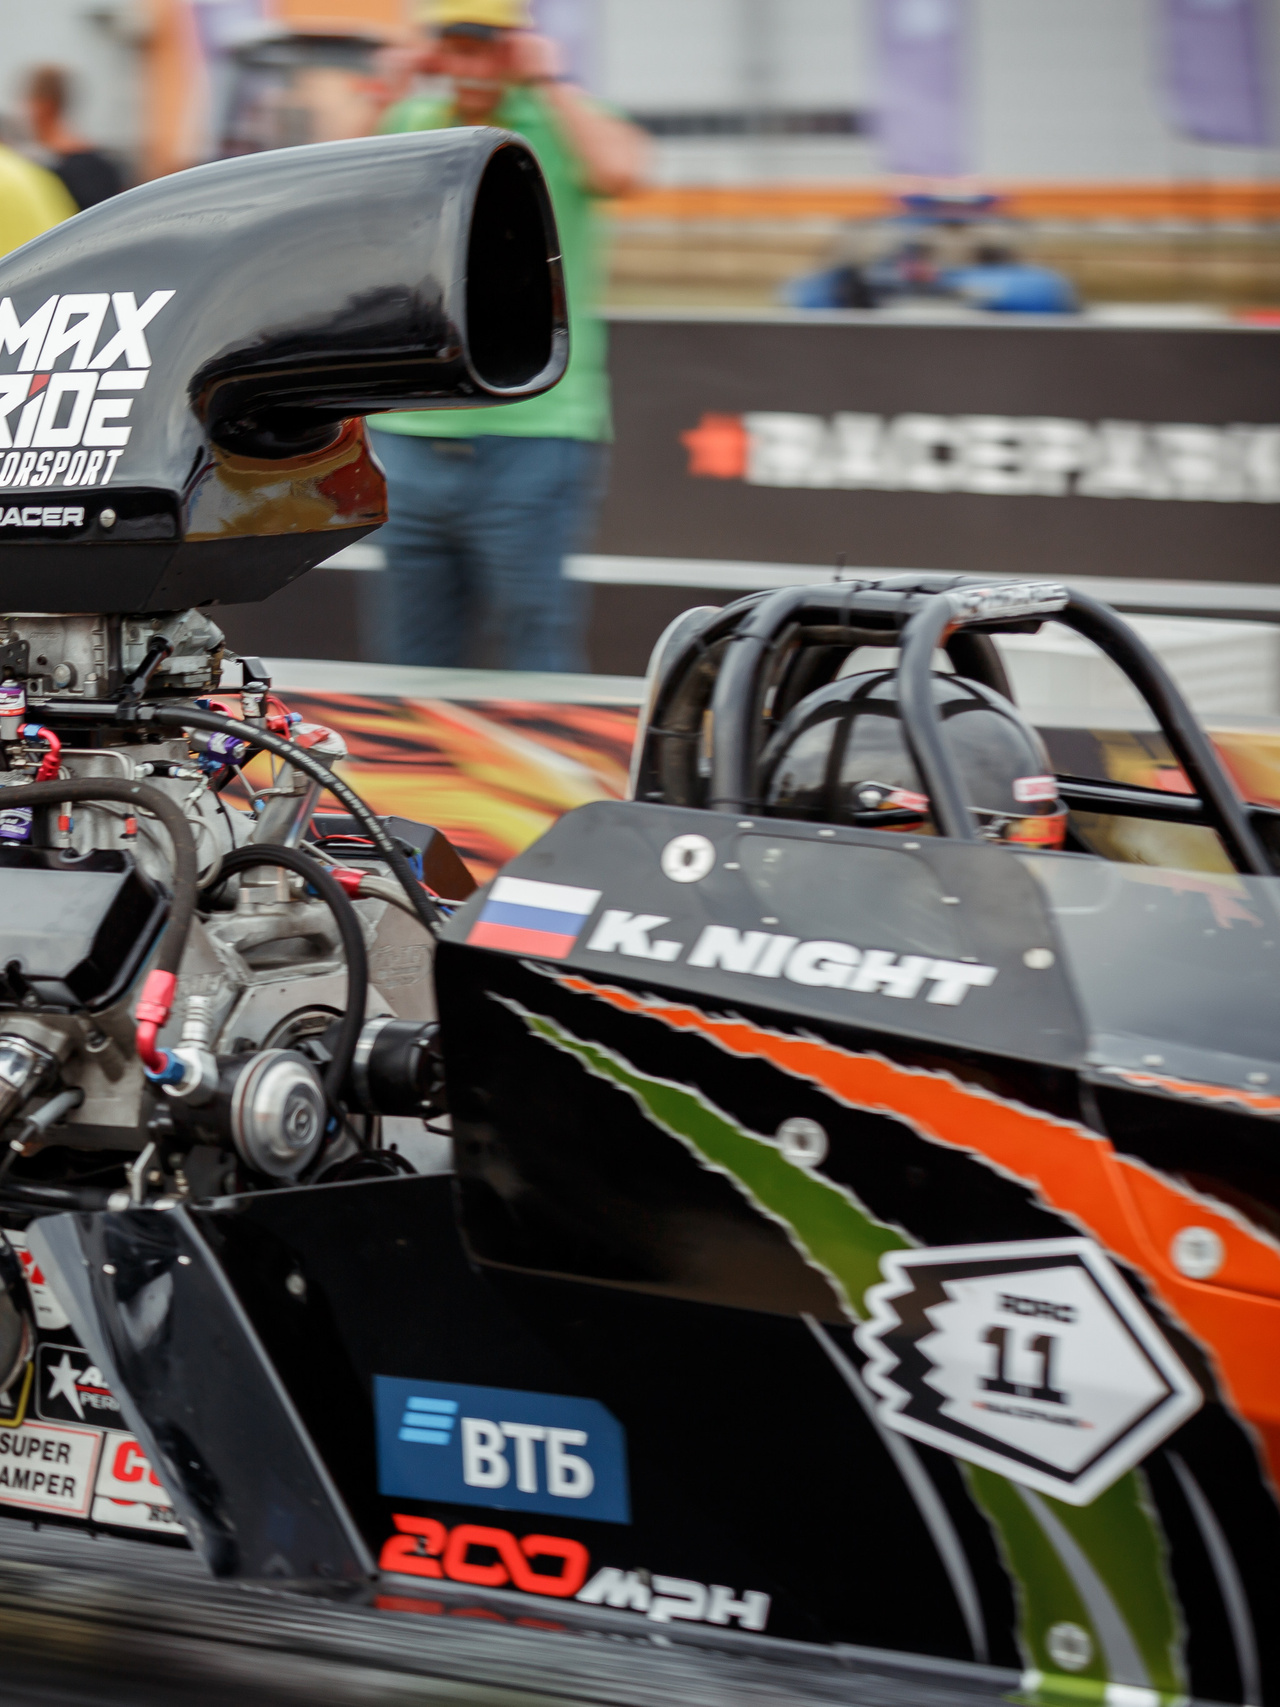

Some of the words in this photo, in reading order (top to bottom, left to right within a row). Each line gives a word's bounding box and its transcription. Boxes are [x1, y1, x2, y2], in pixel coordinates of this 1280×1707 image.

[587, 909, 684, 963] K.
[686, 925, 999, 1007] NIGHT
[978, 1324, 1070, 1405] 11
[461, 1417, 595, 1499] ВТБ
[378, 1513, 590, 1598] 200
[576, 1566, 771, 1632] MPH
